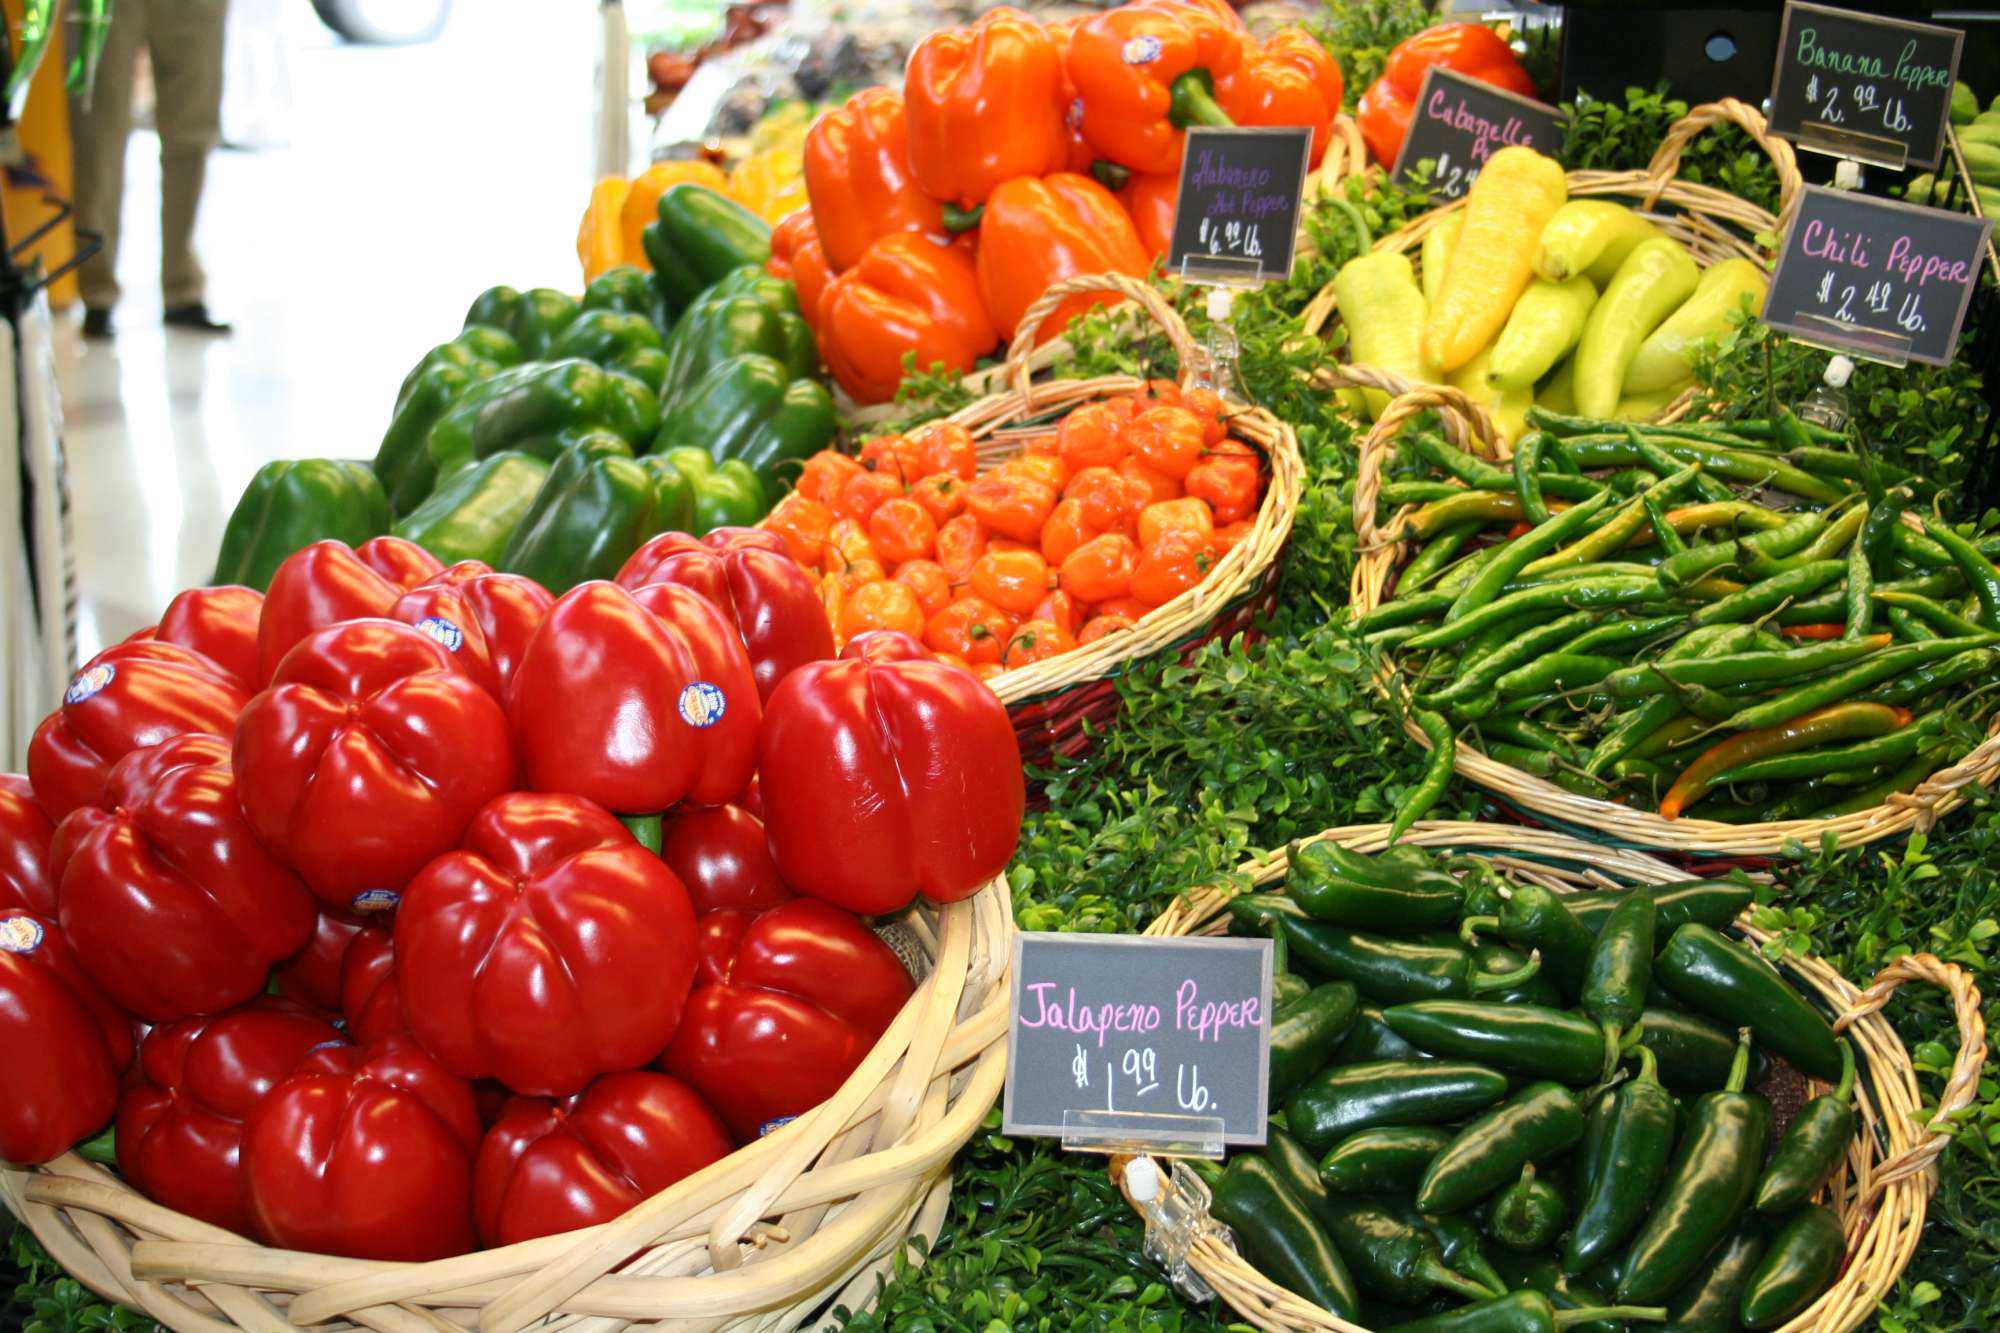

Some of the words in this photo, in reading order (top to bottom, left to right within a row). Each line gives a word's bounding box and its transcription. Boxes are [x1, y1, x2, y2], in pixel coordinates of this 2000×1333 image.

[1797, 28, 1890, 78] Banana
[1802, 218, 1873, 269] Chili
[1019, 981, 1161, 1048] Jalapeno
